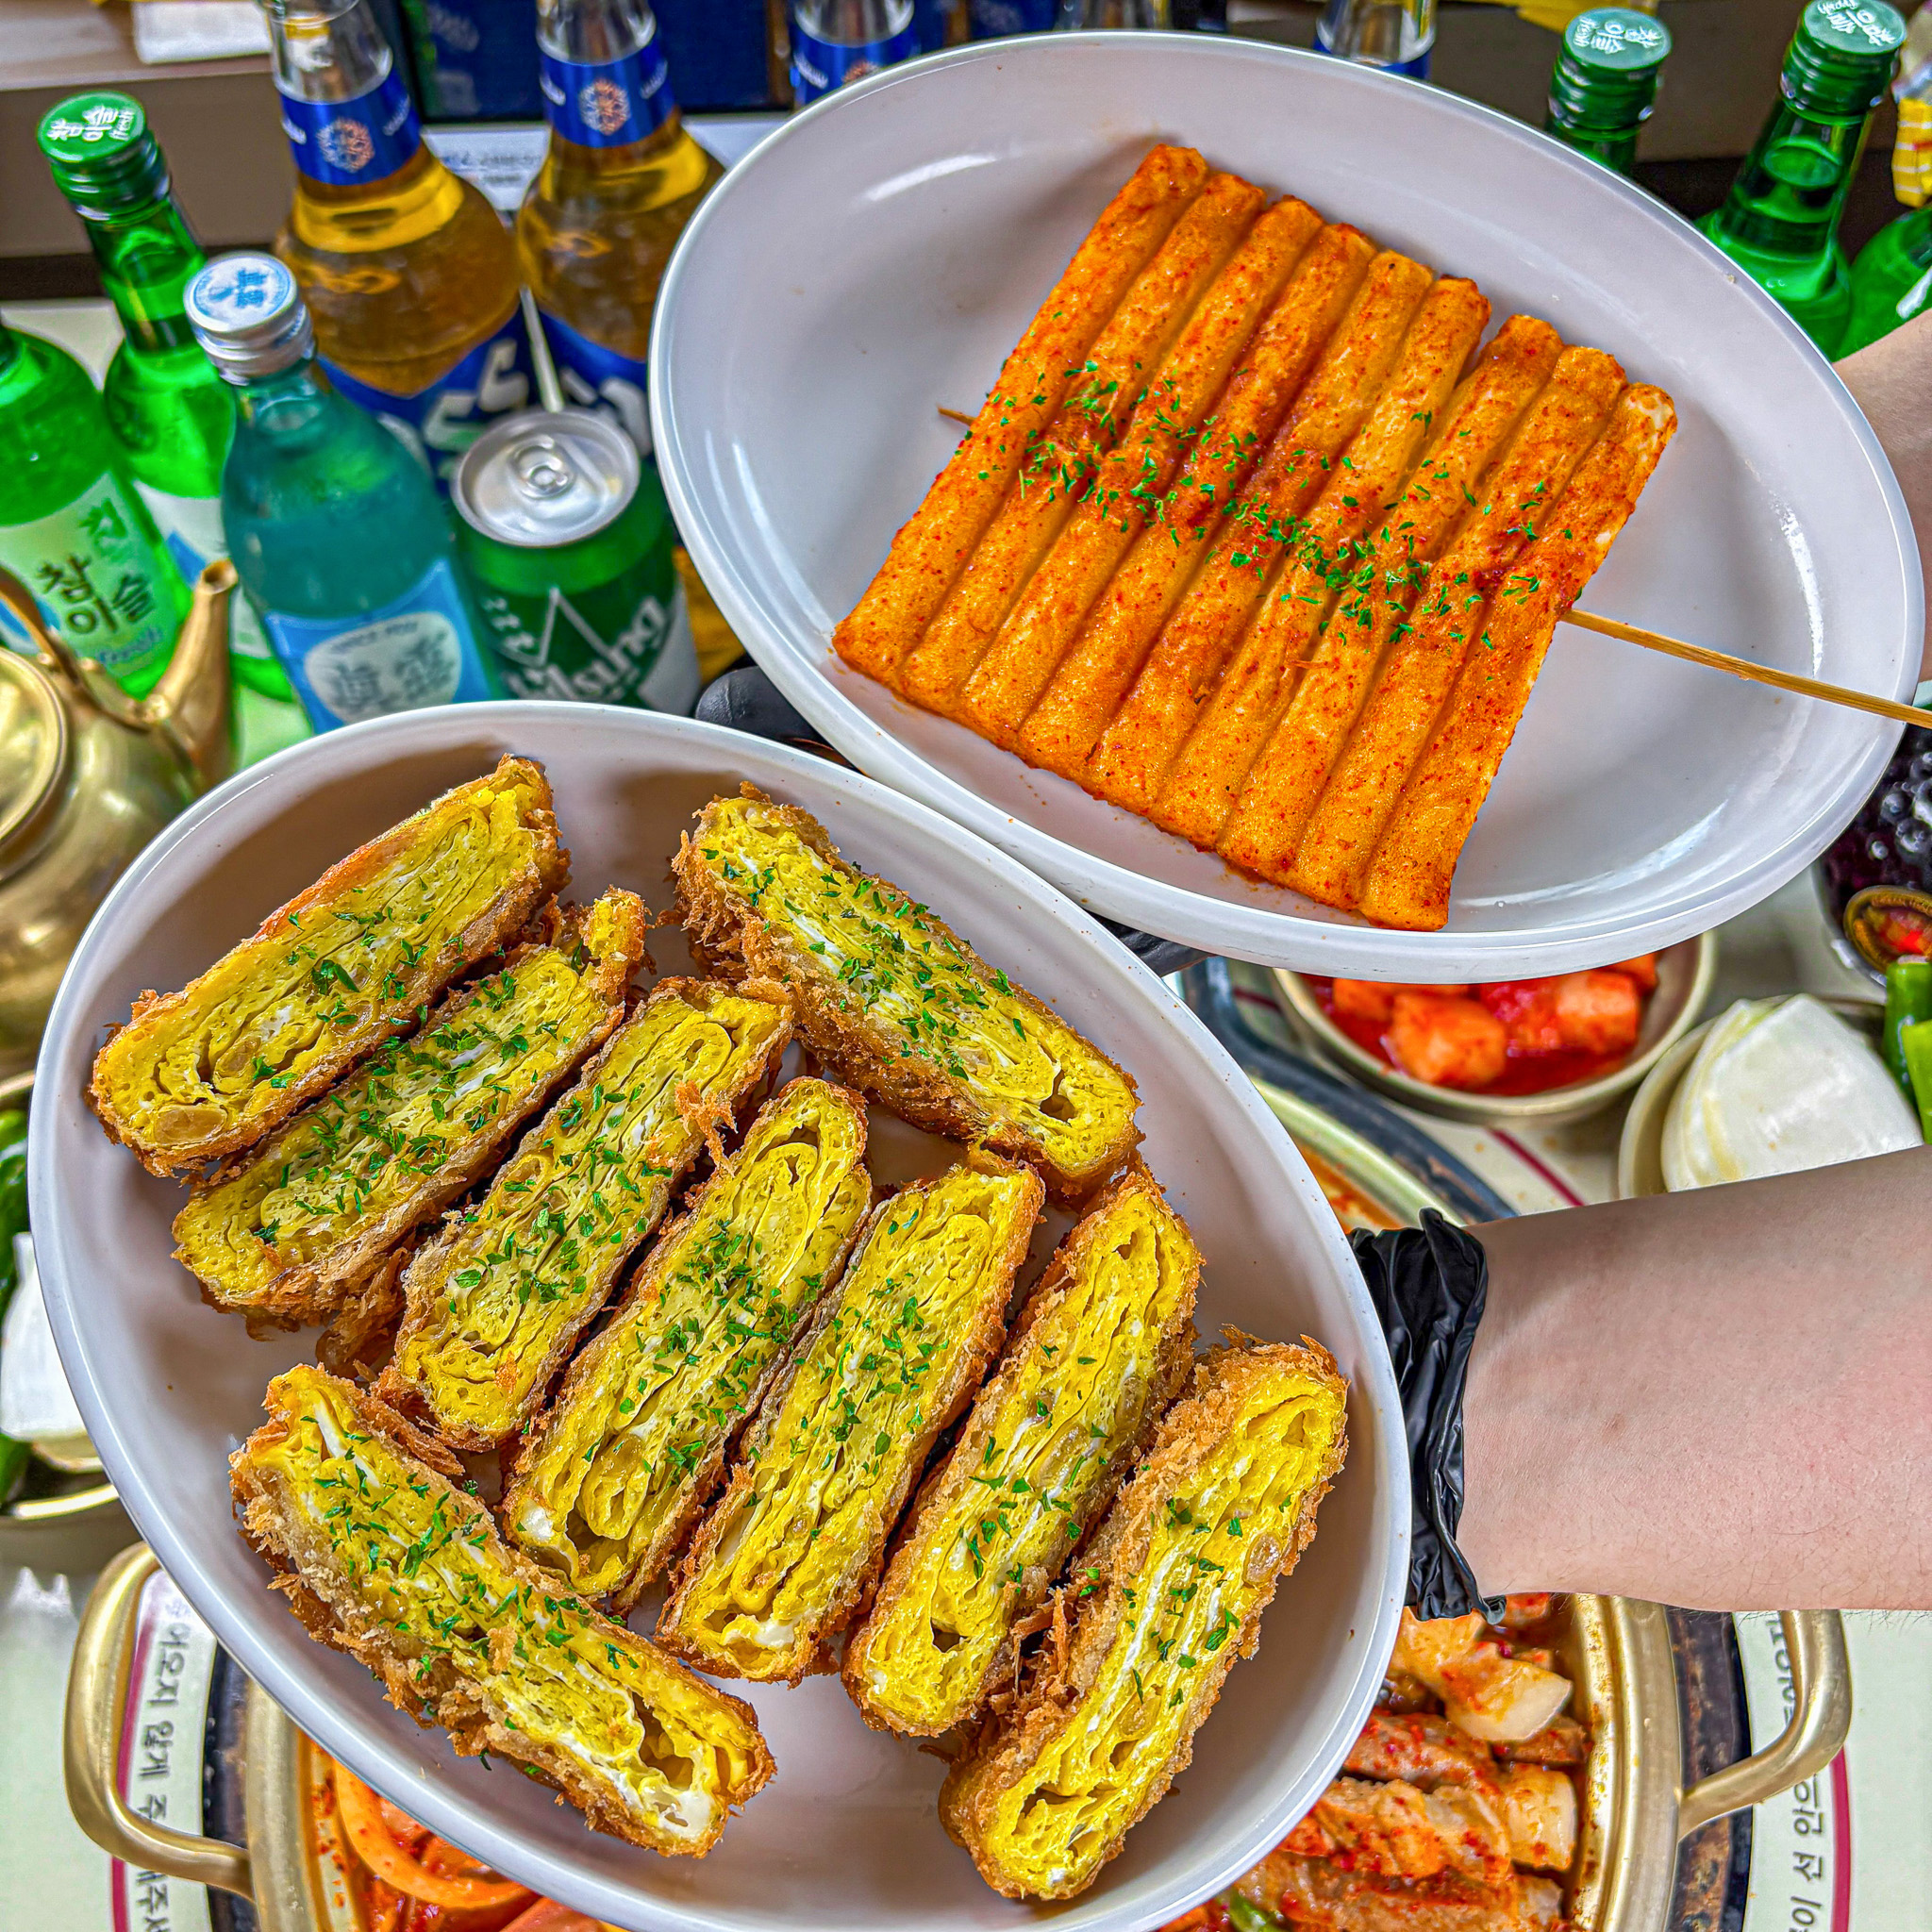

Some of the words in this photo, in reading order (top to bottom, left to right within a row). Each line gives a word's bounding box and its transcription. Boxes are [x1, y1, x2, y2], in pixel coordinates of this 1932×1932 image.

[1591, 21, 1663, 55] 참이슬
[47, 105, 119, 142] 참이슬
[36, 553, 155, 634] 참이슬
[138, 1719, 175, 1781] 않게
[1792, 1774, 1825, 1836] 안으
[1792, 1850, 1824, 1883] 선
